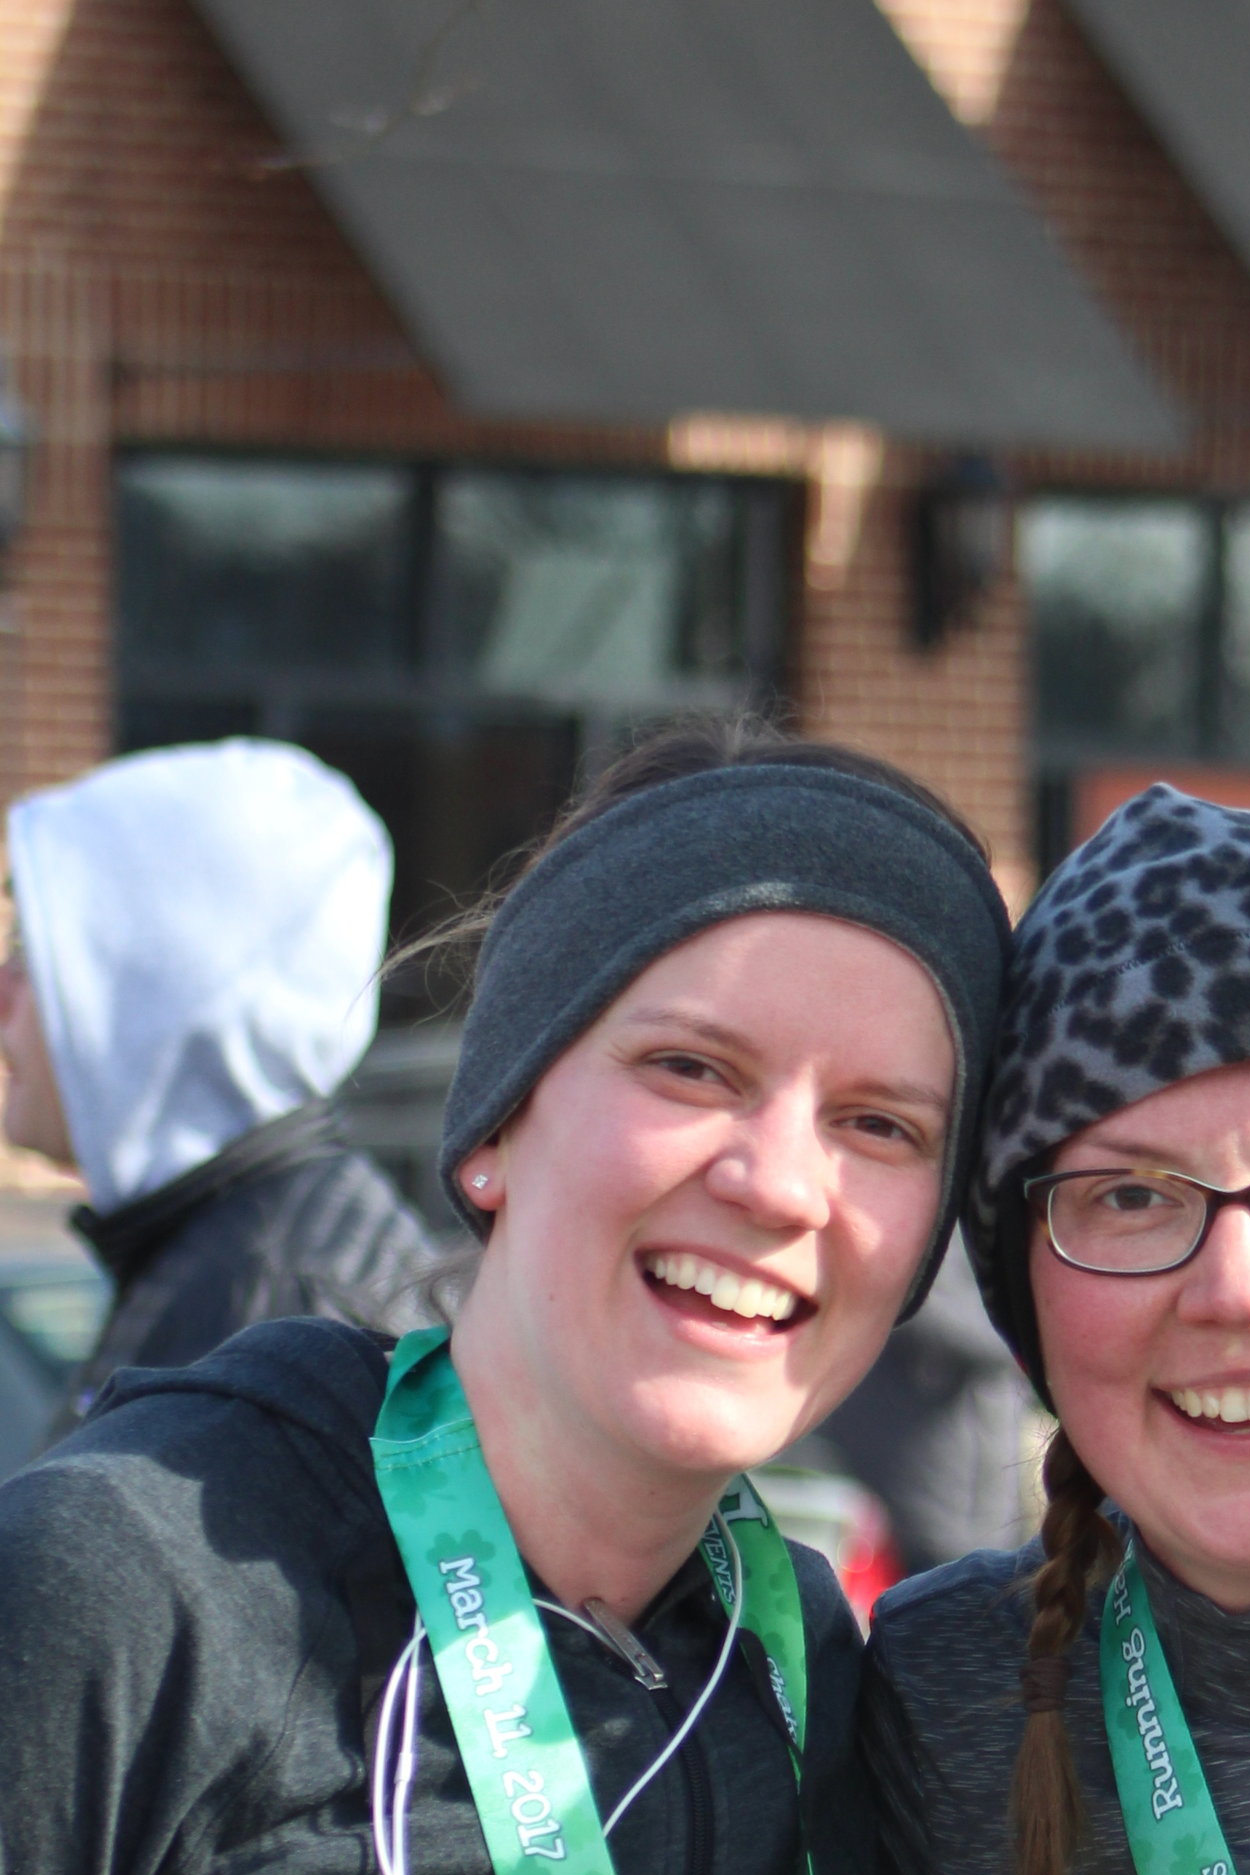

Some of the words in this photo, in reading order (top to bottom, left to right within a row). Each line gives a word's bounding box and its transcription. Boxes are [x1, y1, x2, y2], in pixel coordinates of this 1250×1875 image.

[439, 1556, 515, 1698] March
[502, 1770, 567, 1863] 2017
[1122, 1627, 1183, 1820] Running
